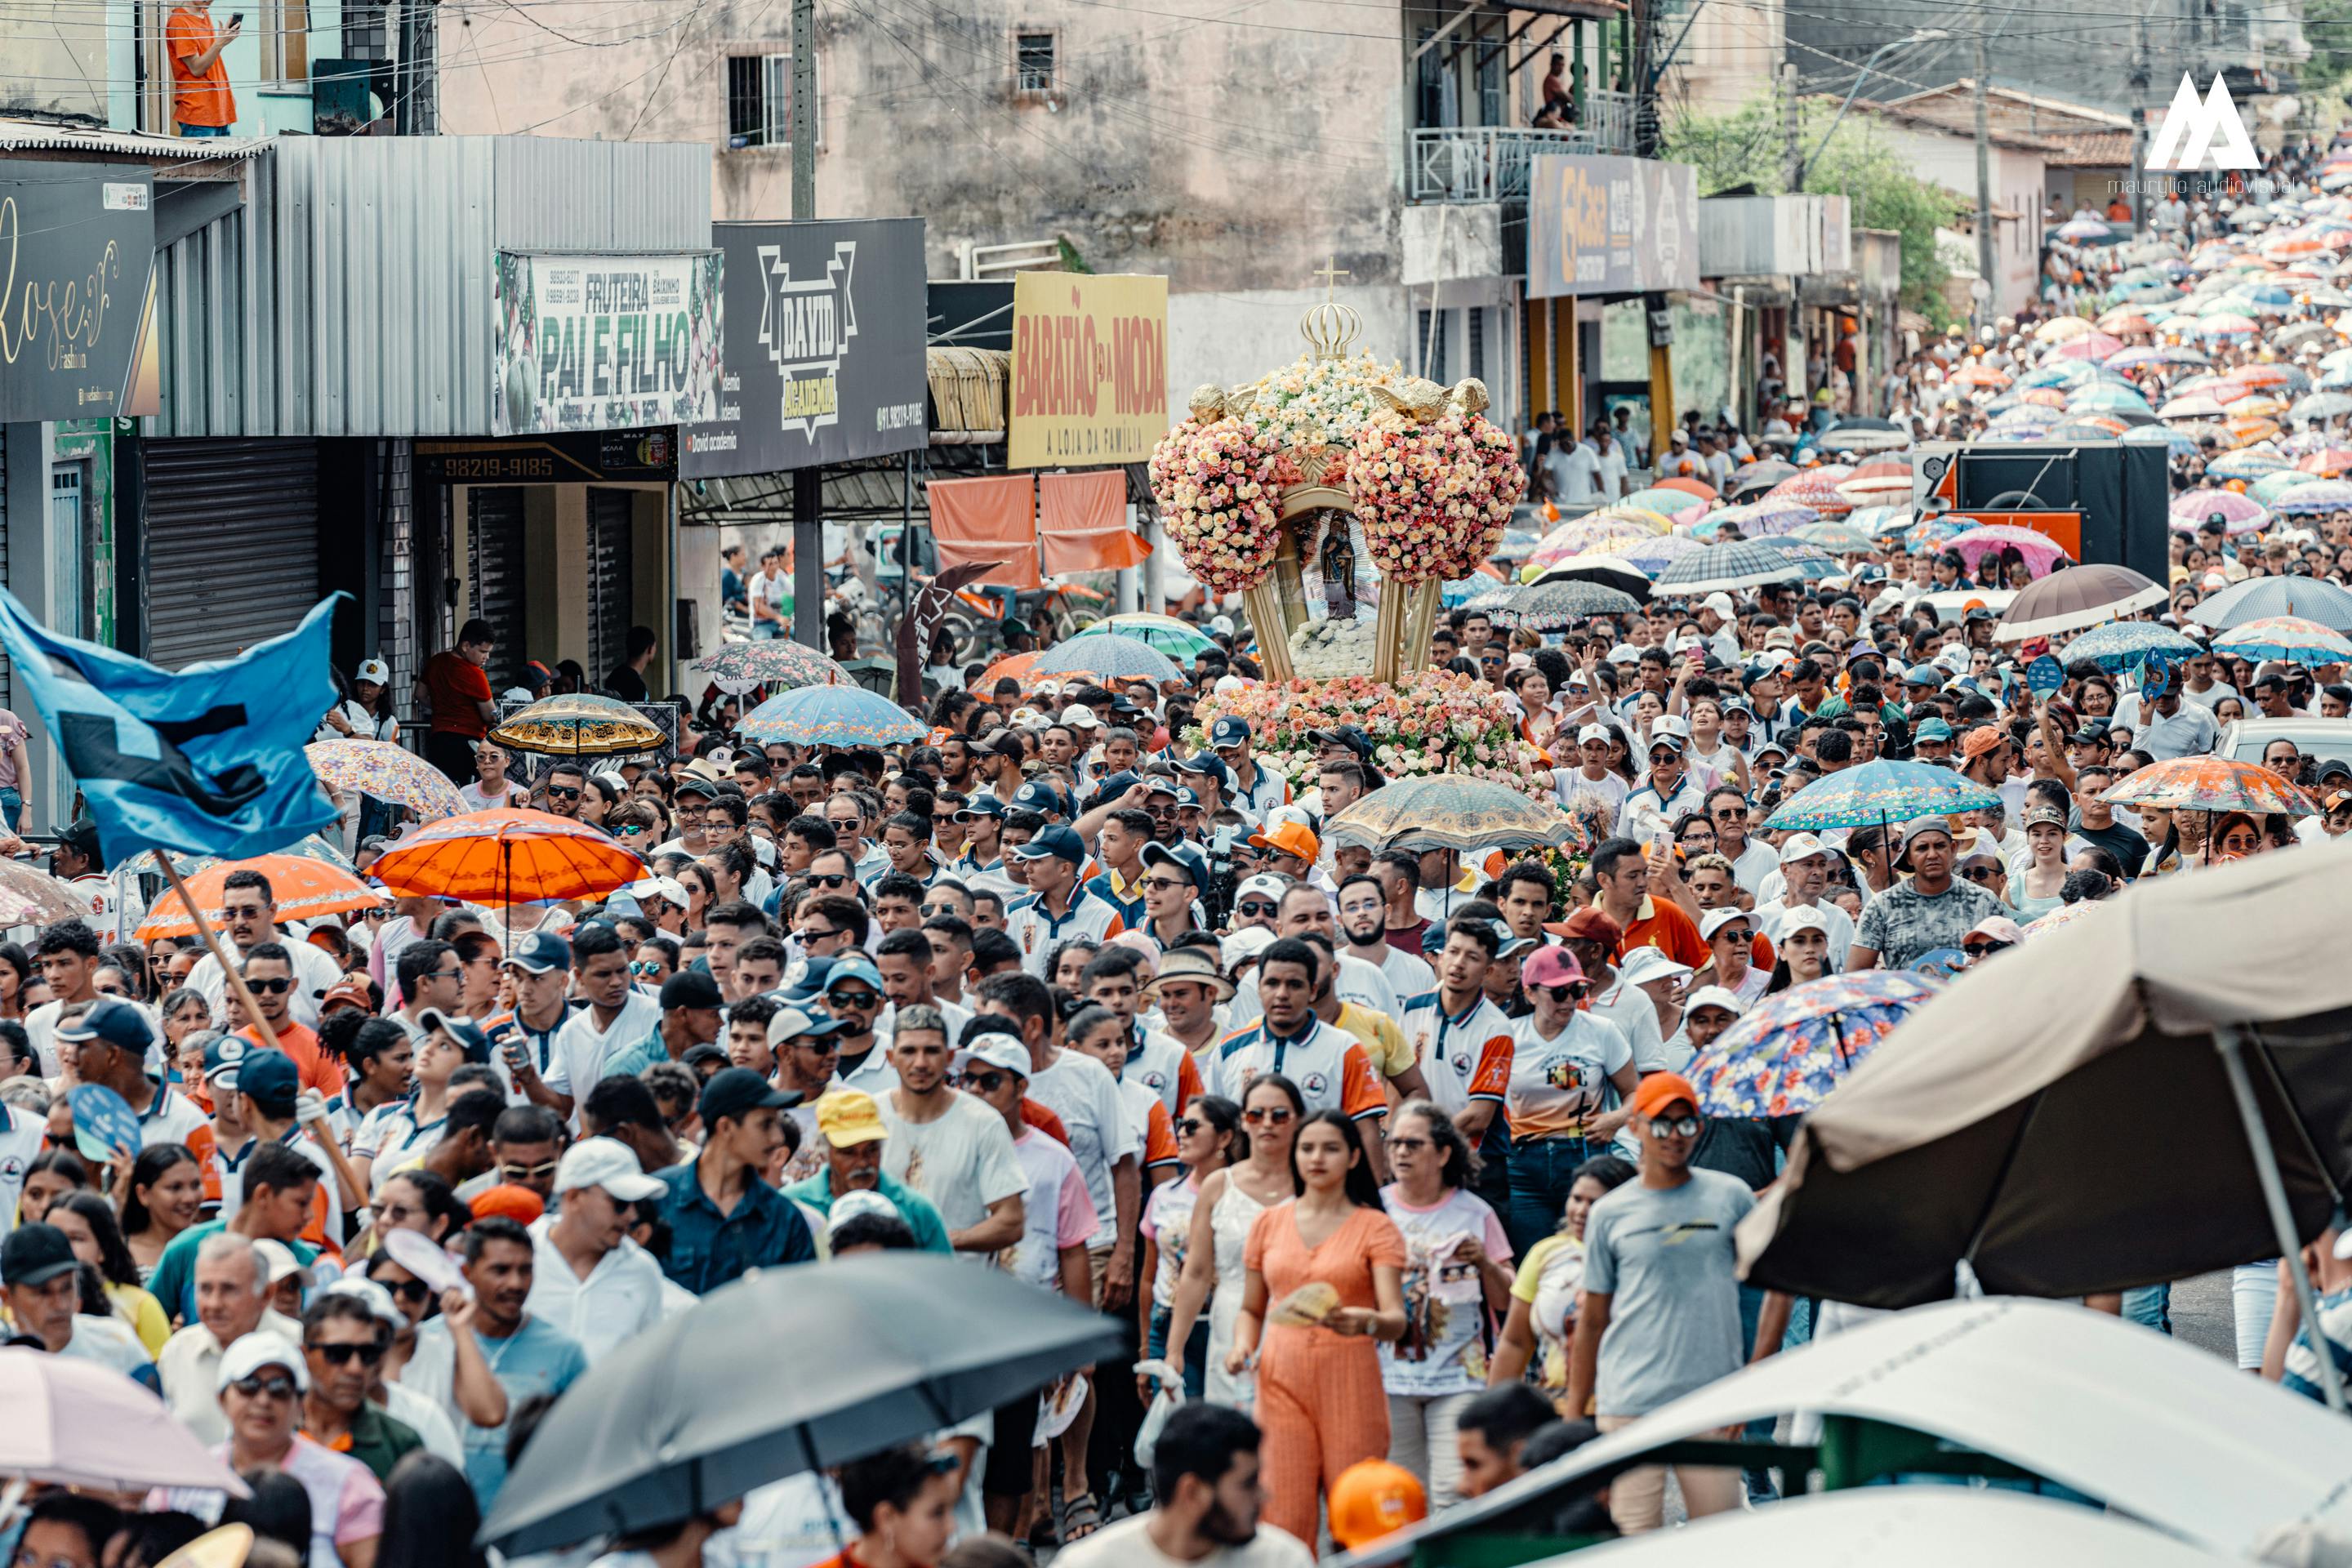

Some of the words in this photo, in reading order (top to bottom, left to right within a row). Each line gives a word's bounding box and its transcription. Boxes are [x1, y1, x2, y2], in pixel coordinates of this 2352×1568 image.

[586, 272, 648, 314] FRUTEIRA
[653, 278, 679, 295] BAIXINHO
[783, 295, 835, 359] DAVID
[60, 345, 87, 368] Fashion
[540, 315, 586, 399] PAI
[592, 315, 611, 396] E
[616, 310, 690, 394] FILHO
[1015, 285, 1098, 418] BARATÃO
[1098, 342, 1113, 383] DA
[1113, 314, 1166, 416] MODA
[784, 376, 835, 420] ACADEMIA
[693, 432, 708, 452] David
[710, 430, 737, 451] academia
[1047, 430, 1052, 456] A
[1058, 429, 1082, 456] LOJA
[1087, 429, 1098, 455] DA
[1104, 419, 1142, 454] FAMÍLIA
[446, 458, 553, 477] 98219-9185
